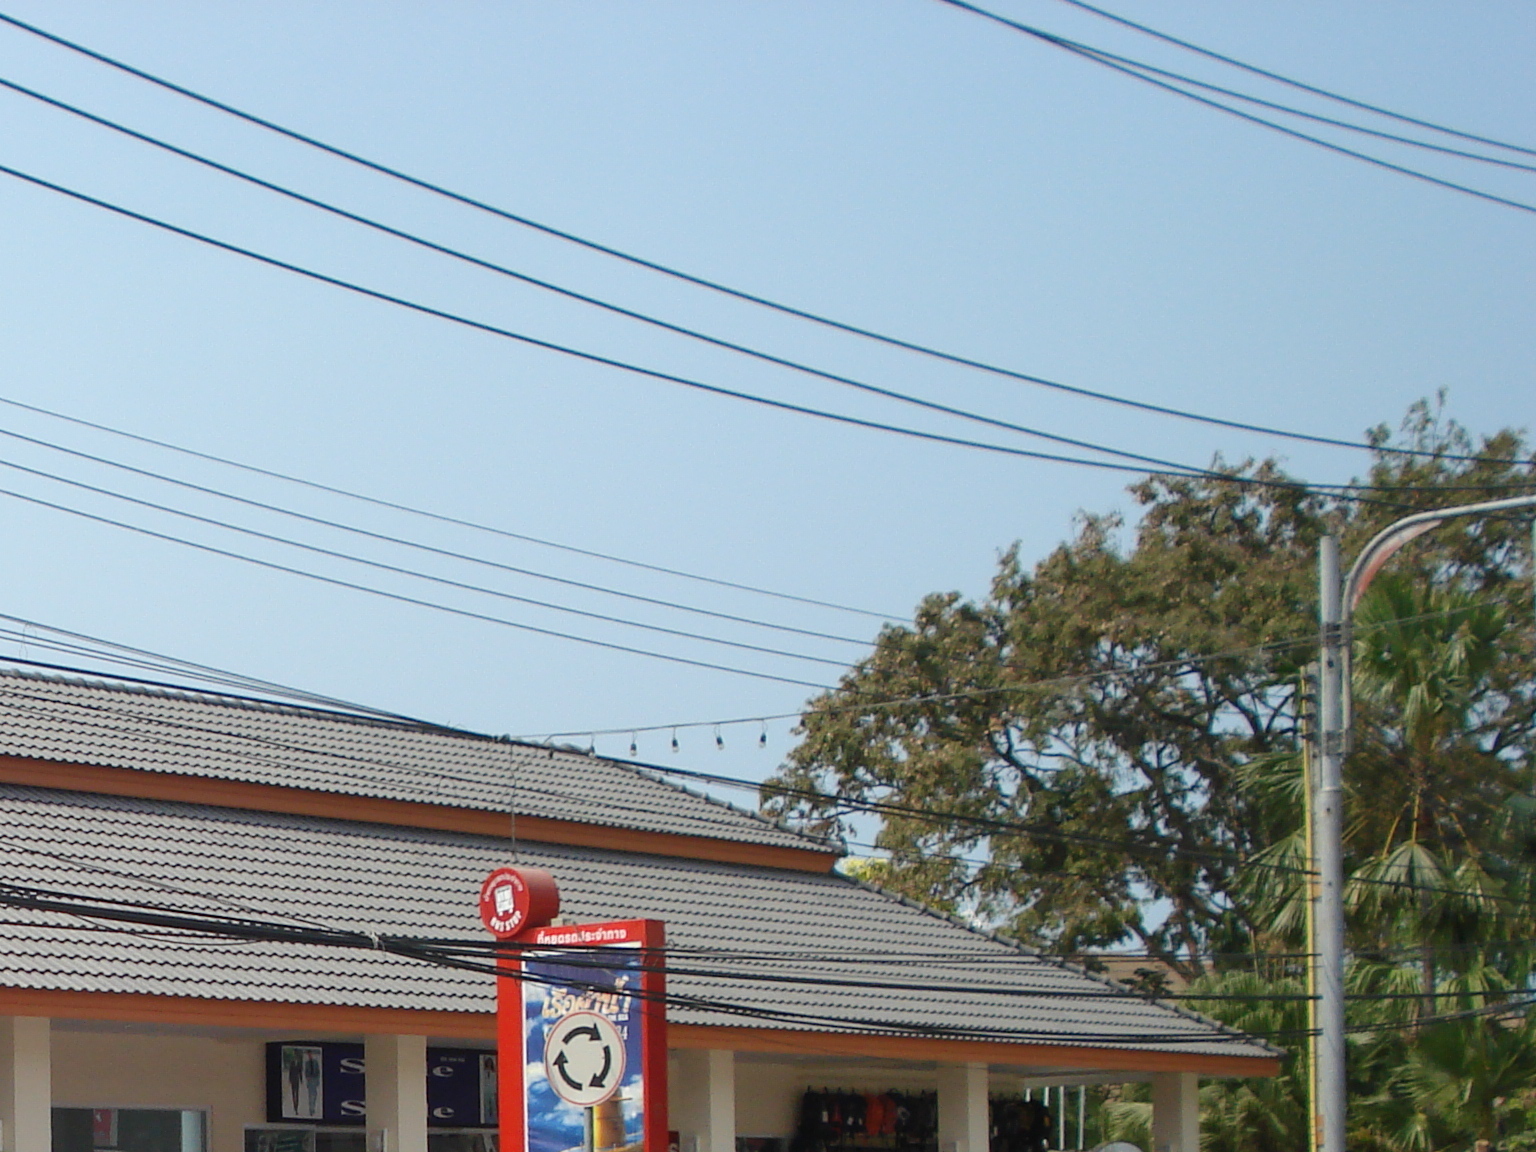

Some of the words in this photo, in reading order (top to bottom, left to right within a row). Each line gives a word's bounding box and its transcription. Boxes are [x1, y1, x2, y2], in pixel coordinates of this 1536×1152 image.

[490, 916, 505, 932] BUS
[505, 910, 522, 931] STOP
[536, 927, 627, 945] ที่หยดรถประจำทาง
